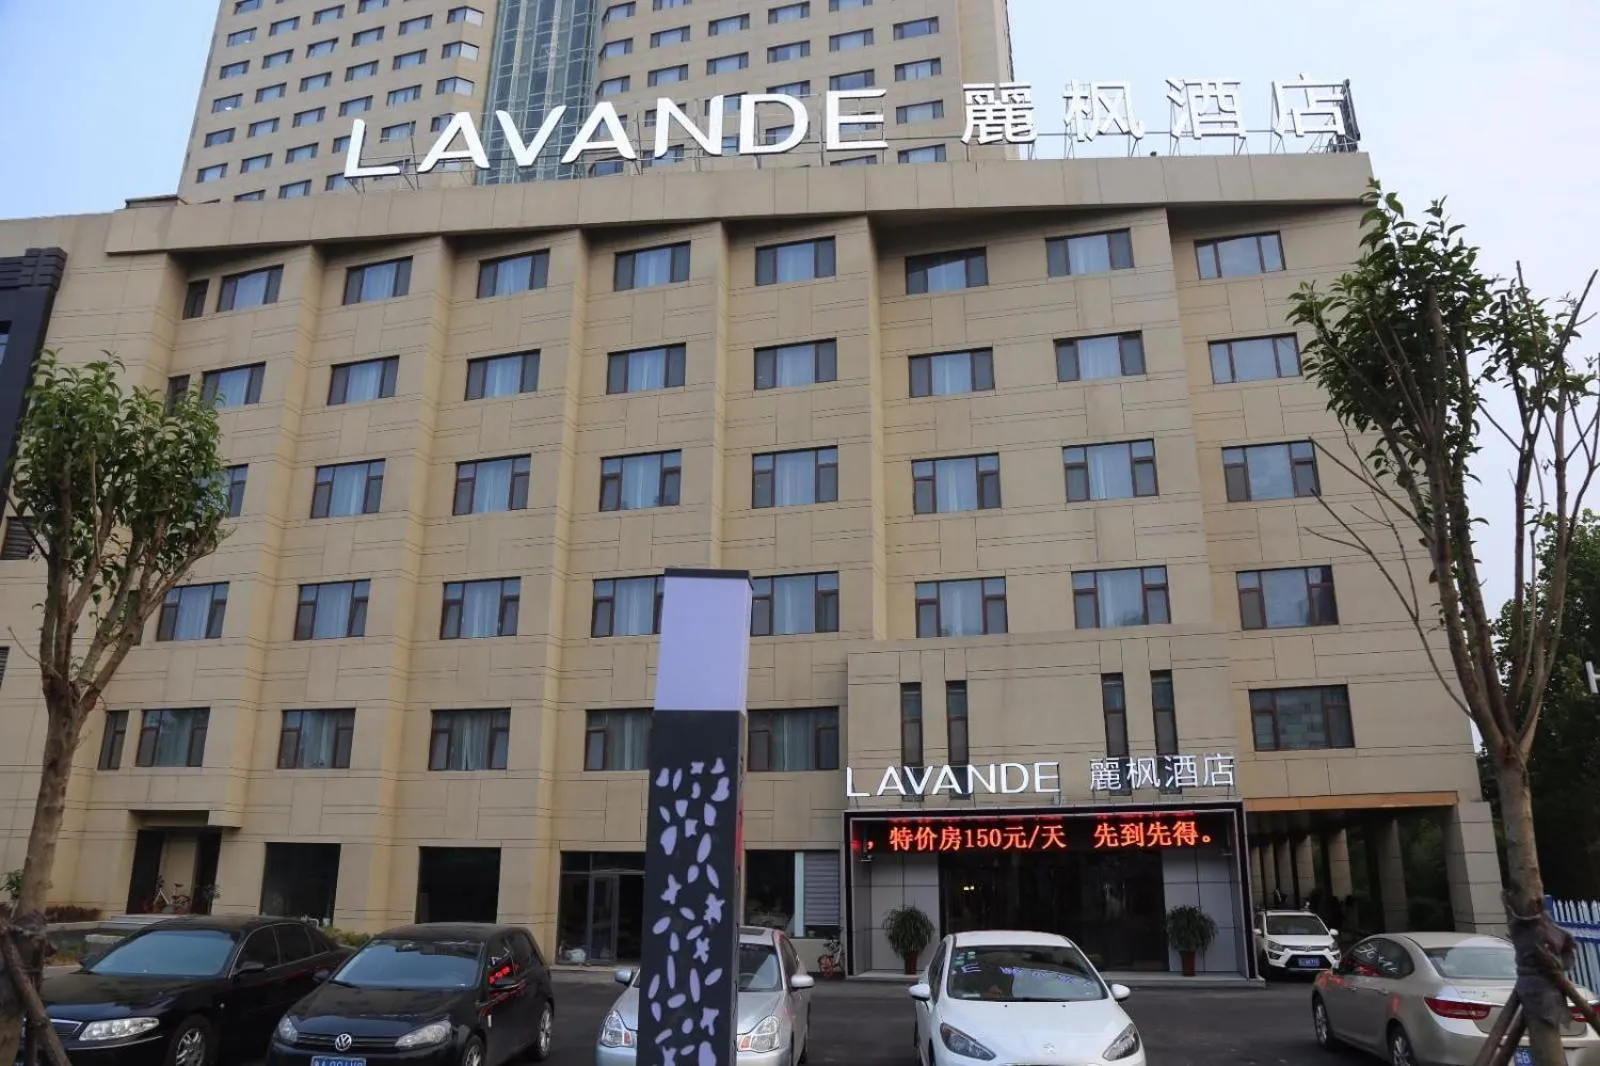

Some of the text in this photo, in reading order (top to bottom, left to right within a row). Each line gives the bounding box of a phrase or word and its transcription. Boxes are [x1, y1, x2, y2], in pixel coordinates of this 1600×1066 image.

[343, 88, 888, 178] LAVANDE
[961, 74, 1348, 144] 麗枫酒店
[846, 762, 1060, 797] LAVANDE
[1089, 753, 1235, 791] 麗枫酒店
